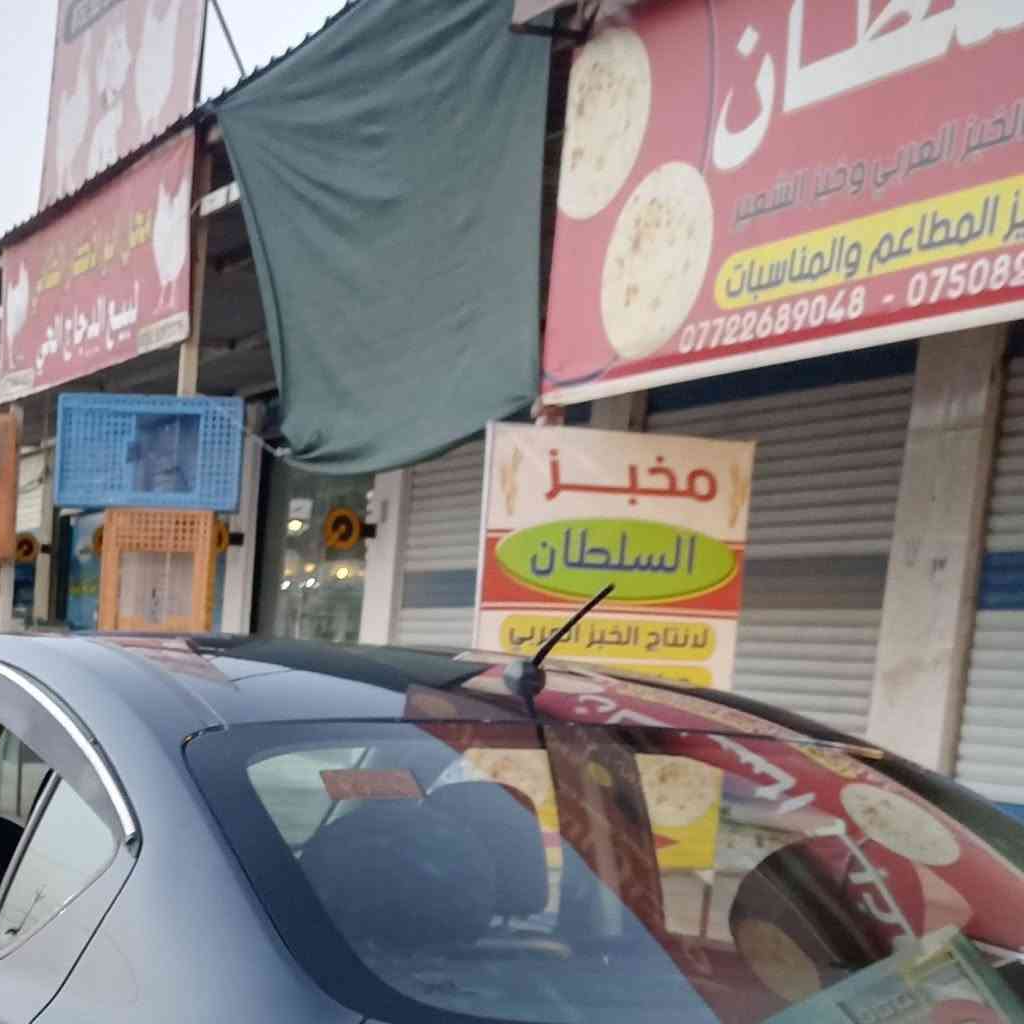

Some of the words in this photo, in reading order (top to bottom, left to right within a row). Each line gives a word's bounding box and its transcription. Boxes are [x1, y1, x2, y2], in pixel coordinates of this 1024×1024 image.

[870, 193, 1000, 272] المطاعم
[725, 235, 863, 299] والمناسبات
[545, 448, 718, 505] مخبز
[530, 528, 698, 577] السلطان
[586, 621, 640, 649] الخبز
